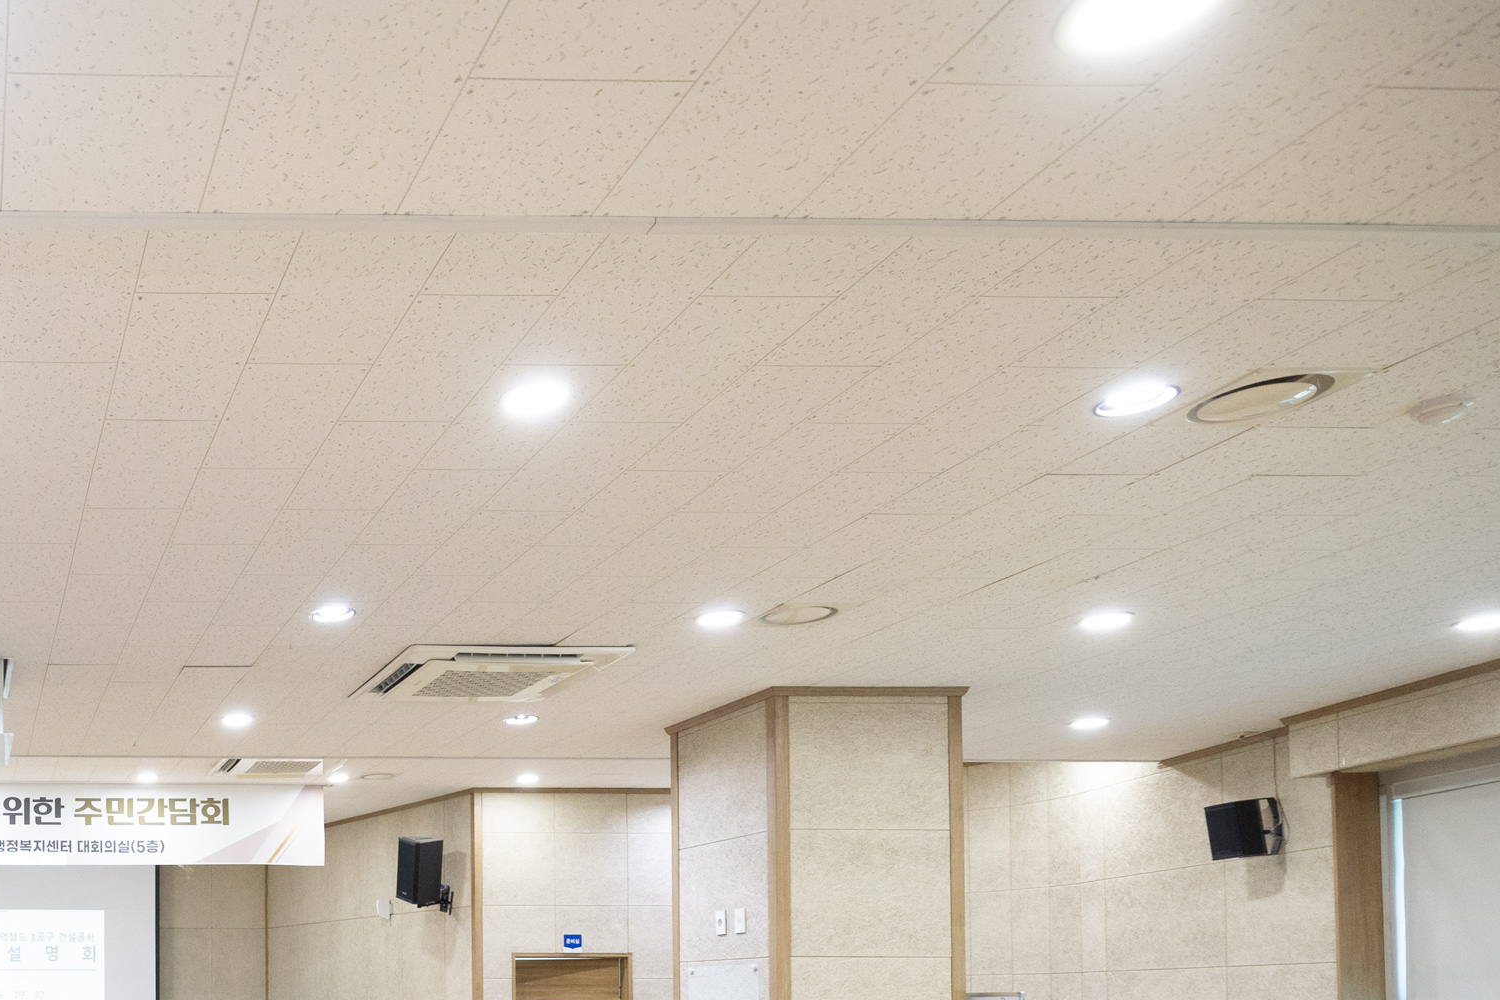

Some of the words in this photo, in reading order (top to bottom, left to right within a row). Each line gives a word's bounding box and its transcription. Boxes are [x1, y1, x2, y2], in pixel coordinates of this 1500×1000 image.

[2, 796, 65, 826] 위한
[73, 797, 230, 826] 주민간담회
[77, 839, 165, 854] 대회의실(5층)
[30, 931, 54, 943] 3공구
[57, 931, 96, 943] 건설공사
